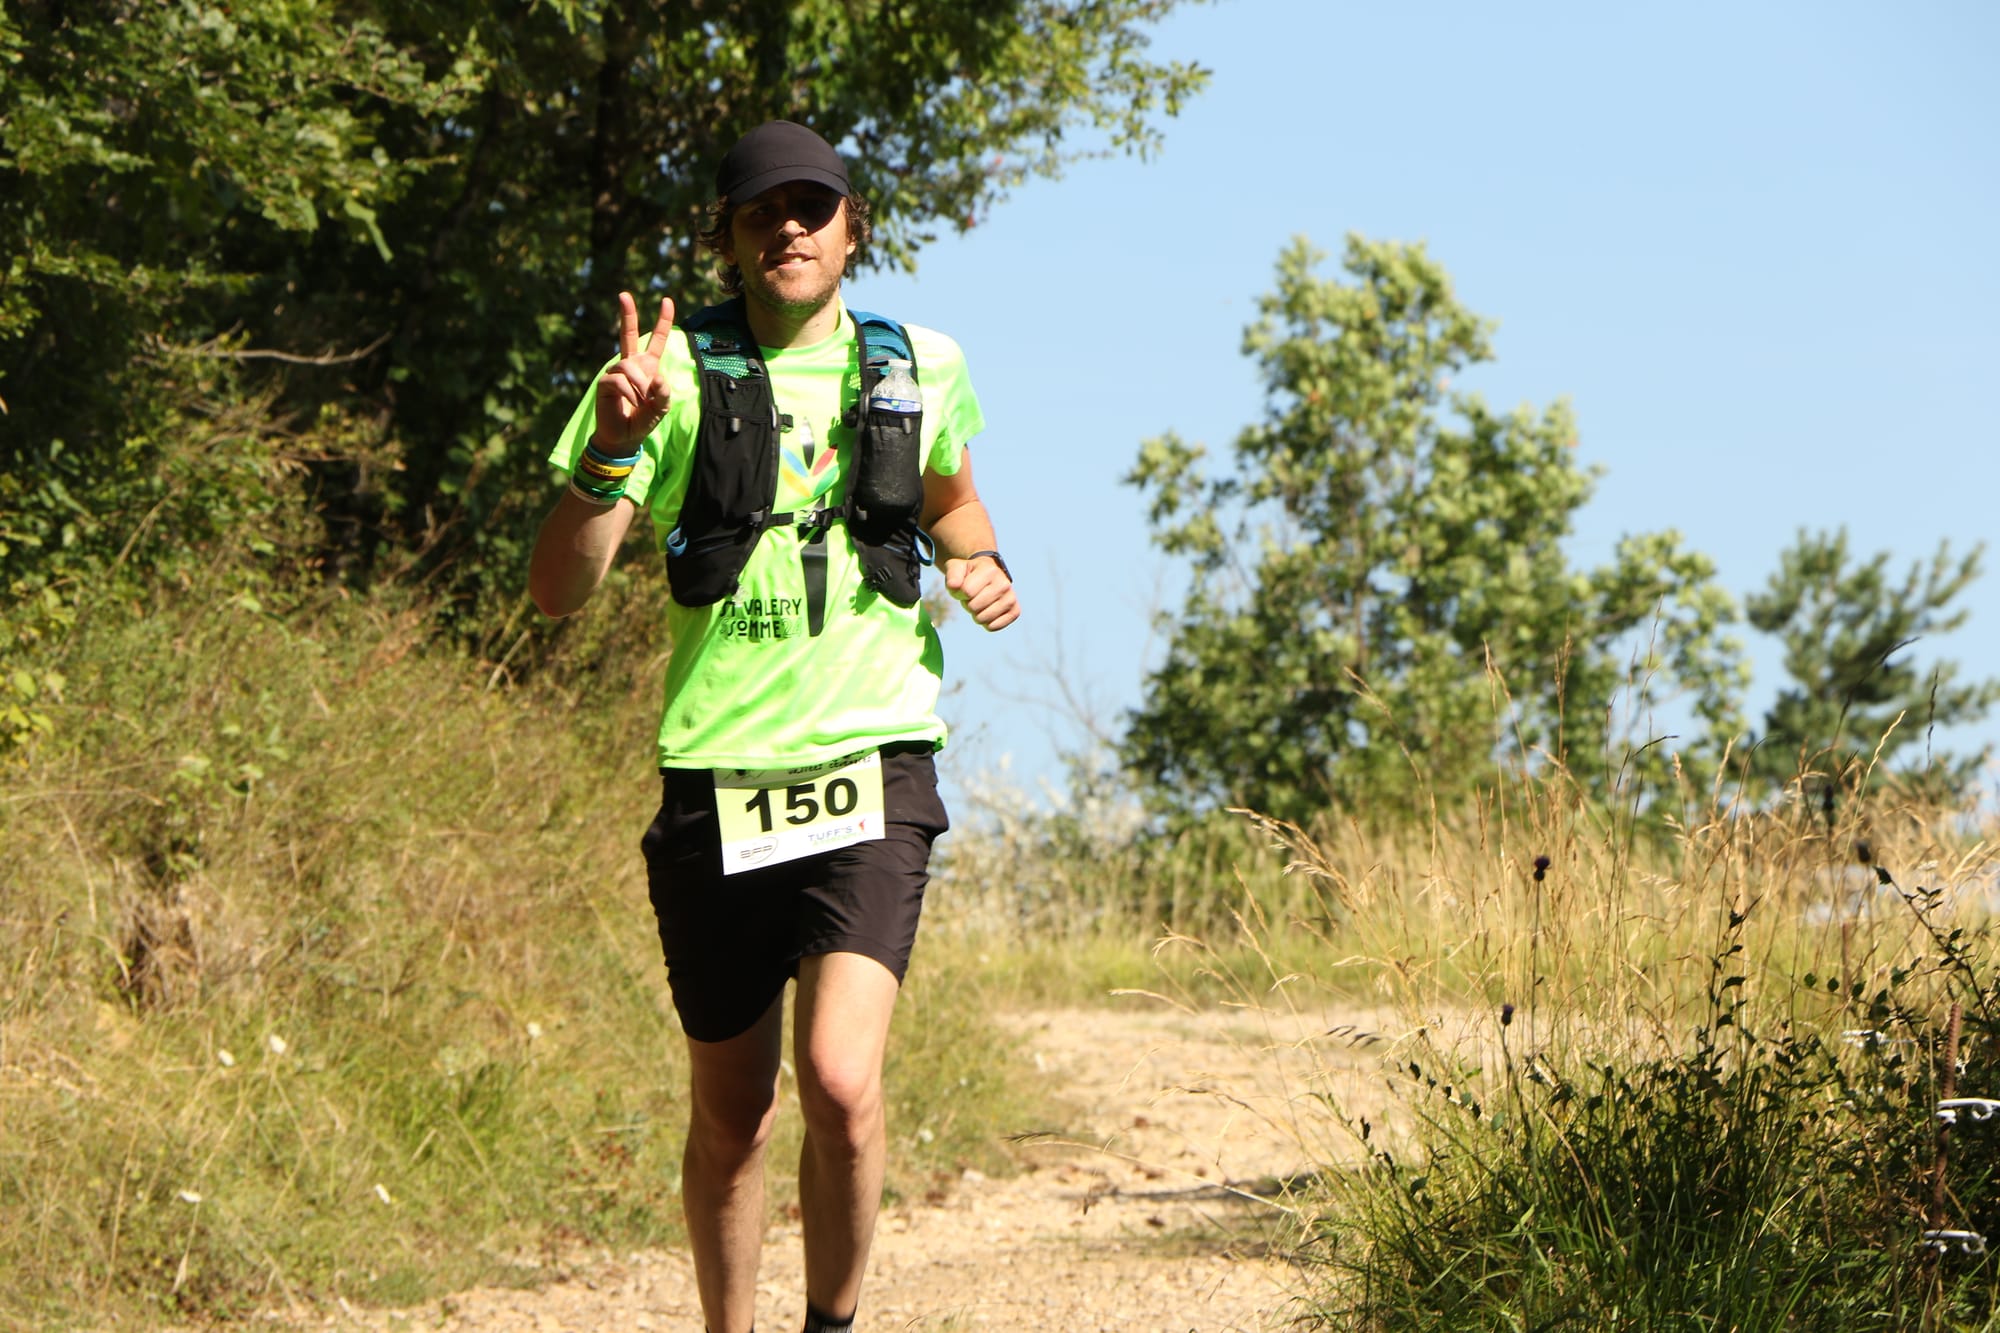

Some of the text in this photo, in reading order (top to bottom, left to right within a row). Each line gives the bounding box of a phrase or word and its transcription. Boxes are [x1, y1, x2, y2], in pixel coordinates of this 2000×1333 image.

[744, 598, 802, 616] VALERY
[727, 620, 781, 638] SOMME
[745, 778, 858, 833] 150
